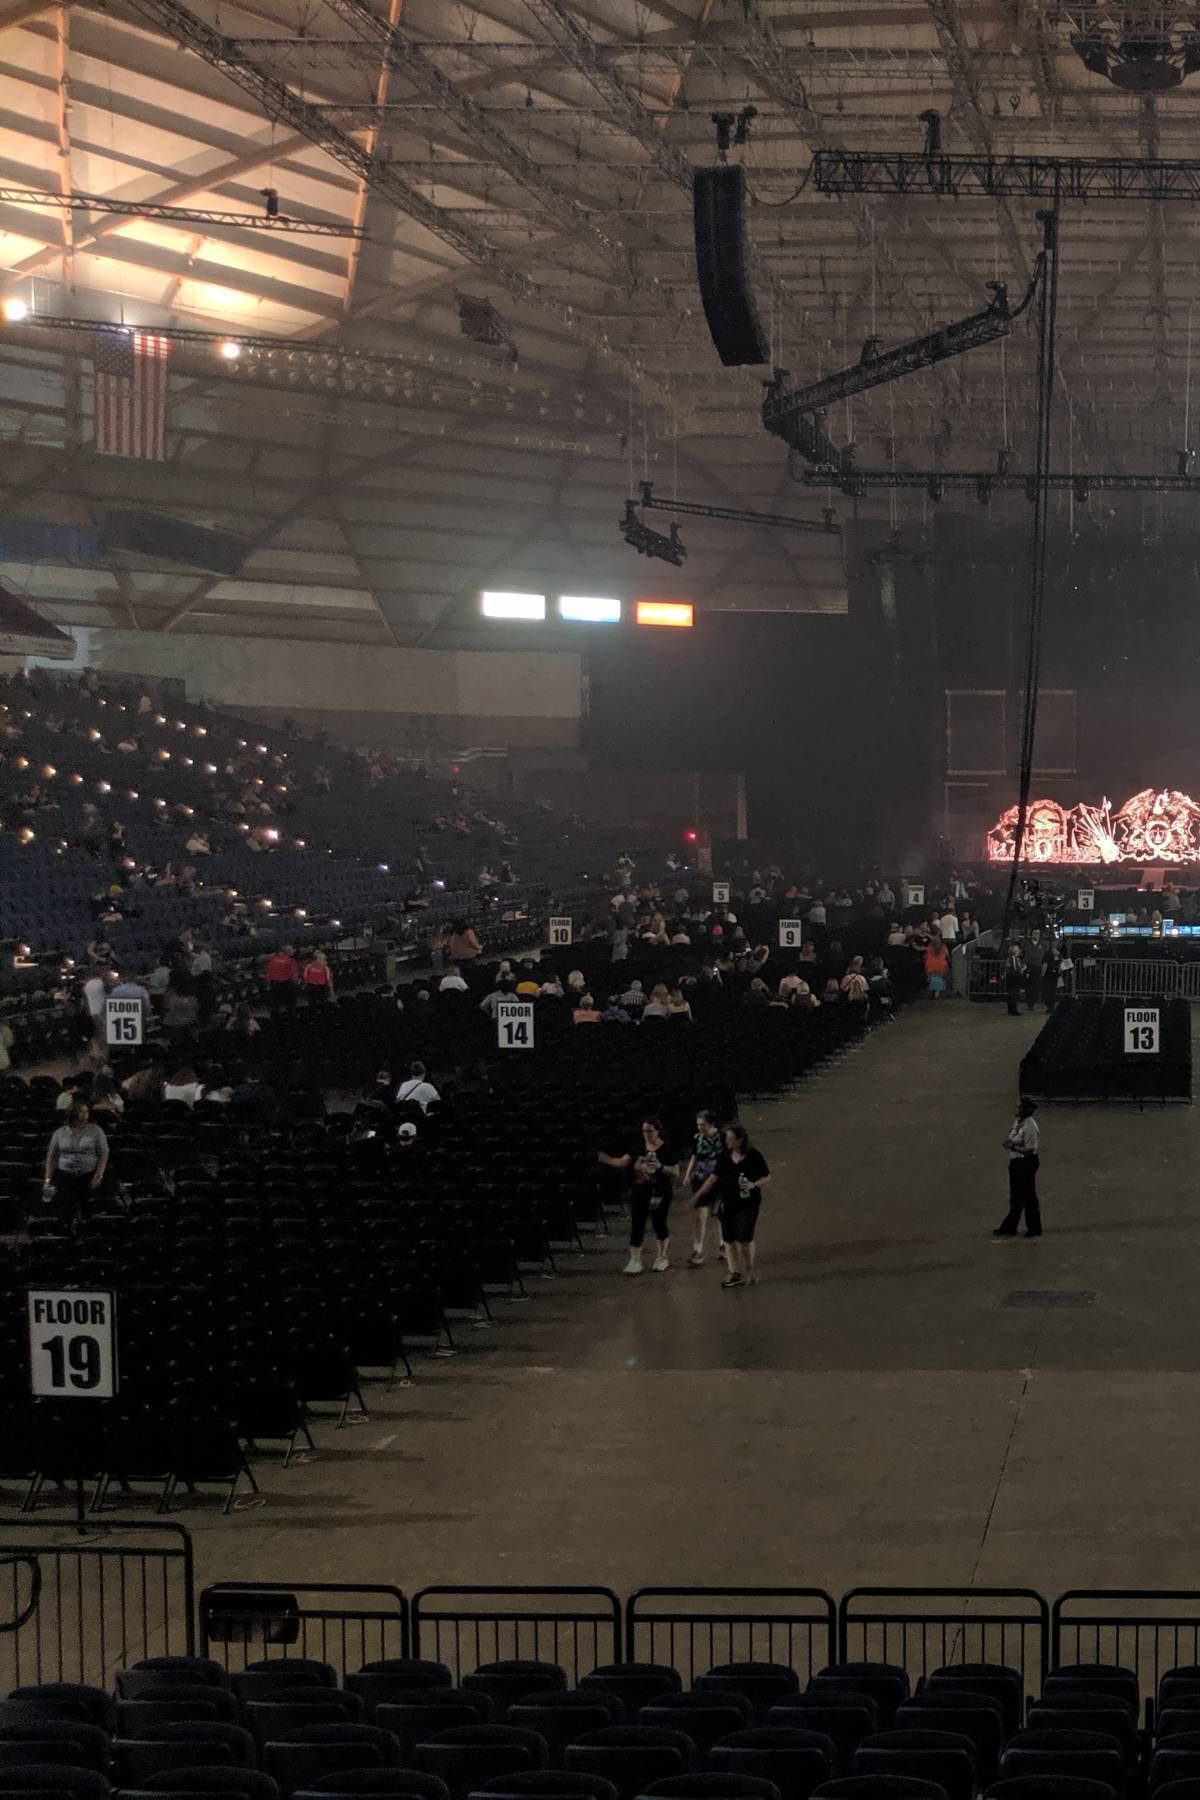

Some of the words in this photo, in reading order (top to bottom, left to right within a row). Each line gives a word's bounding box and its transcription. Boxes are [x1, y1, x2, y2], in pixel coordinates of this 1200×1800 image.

[717, 890, 725, 901] 5
[1082, 897, 1089, 908] 3
[553, 929, 569, 943] 10
[786, 930, 795, 945] 9
[108, 1002, 140, 1013] FLOOR
[500, 1006, 531, 1017] FLOOR
[1127, 1011, 1157, 1022] FLOOR
[111, 1018, 137, 1041] 15
[503, 1022, 528, 1044] 14
[1129, 1027, 1154, 1050] 13
[34, 1298, 105, 1325] FLOOR
[41, 1335, 101, 1389] 19
